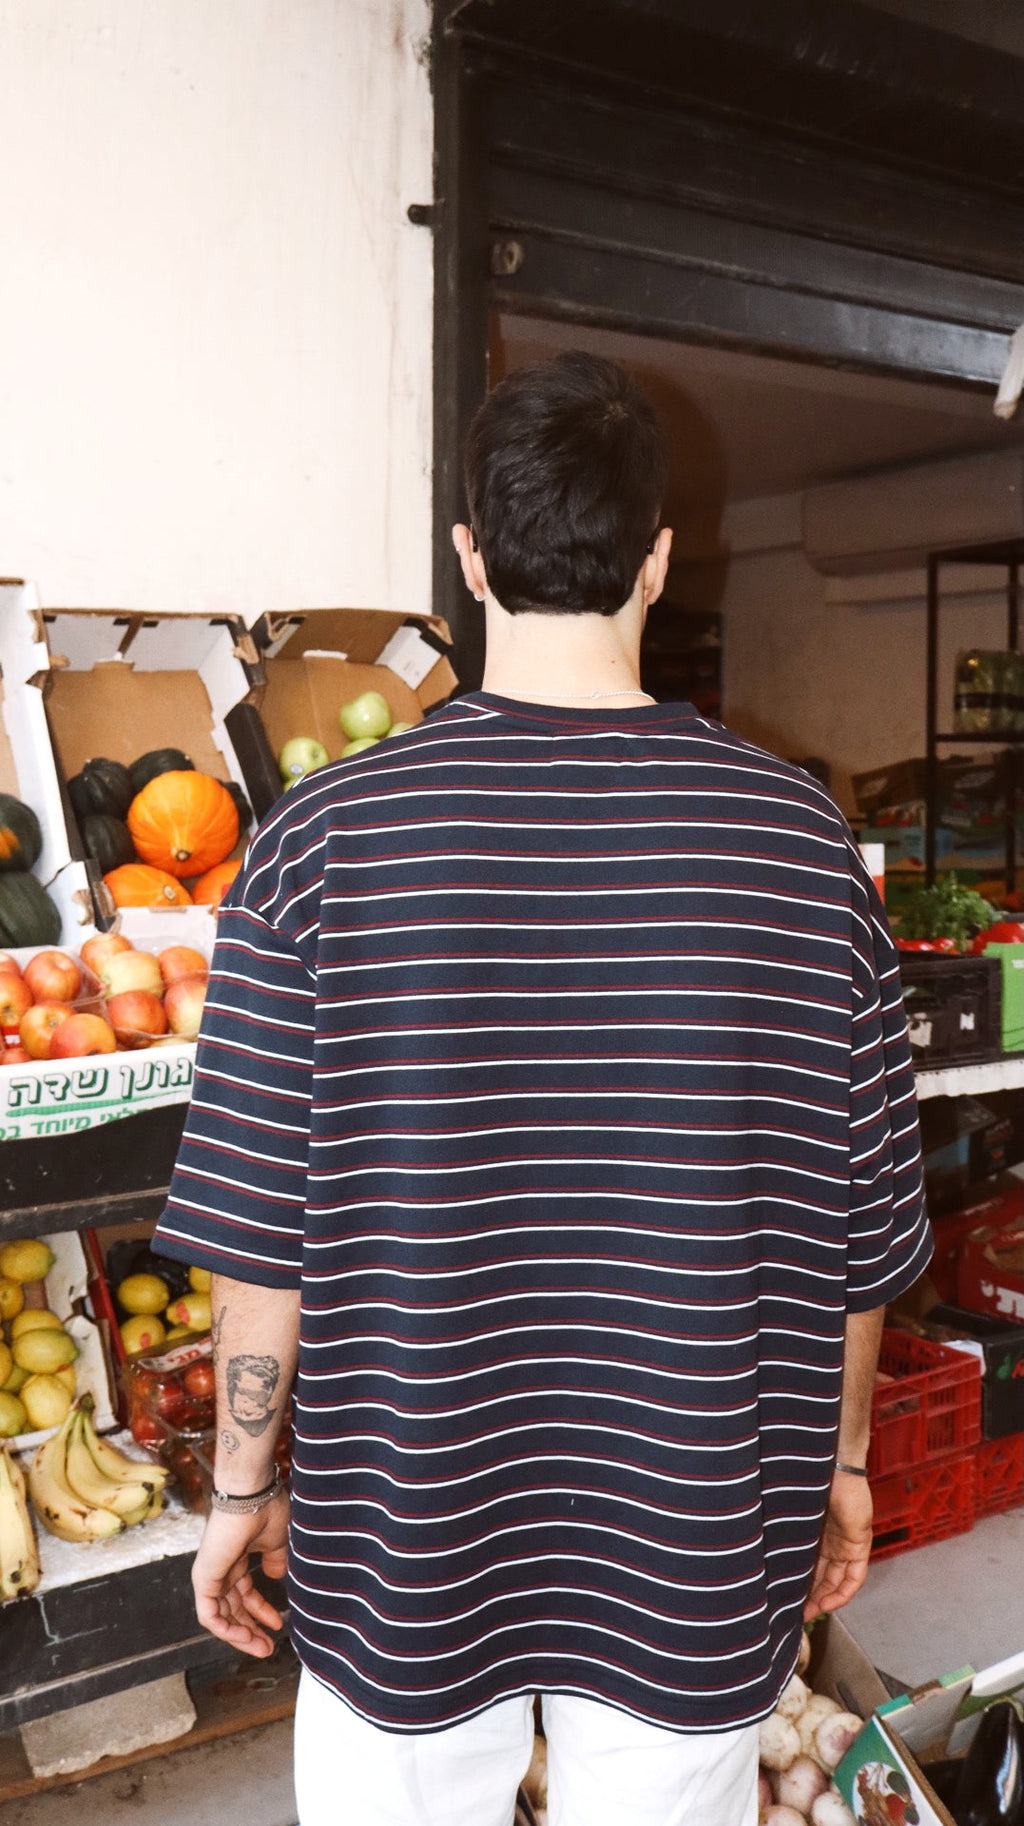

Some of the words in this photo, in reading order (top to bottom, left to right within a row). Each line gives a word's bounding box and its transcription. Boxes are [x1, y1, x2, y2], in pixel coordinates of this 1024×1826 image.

[8, 1068, 109, 1106] שדה
[120, 1057, 193, 1099] גונן
[30, 1116, 92, 1135] מיוחד
